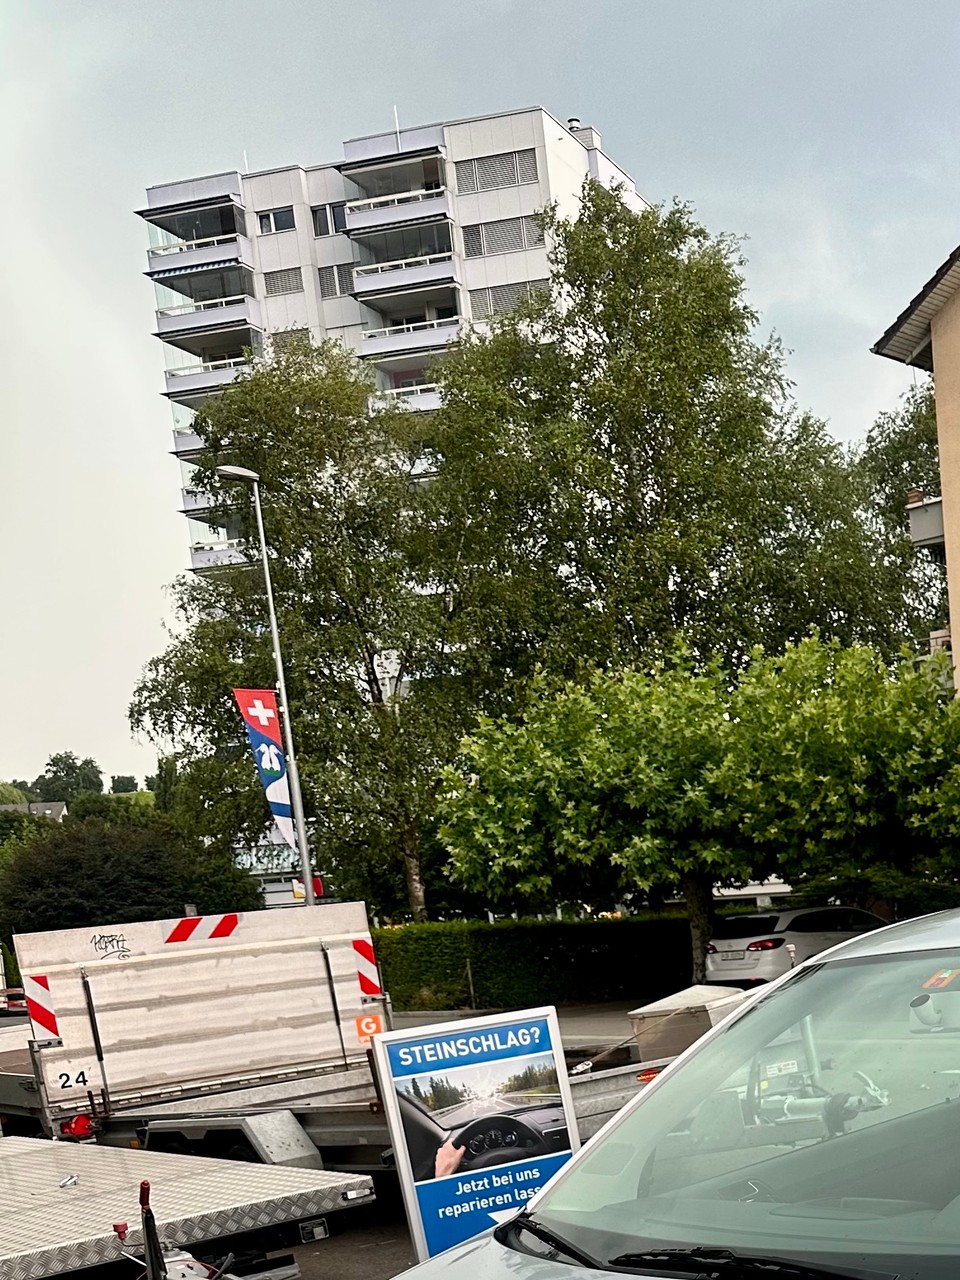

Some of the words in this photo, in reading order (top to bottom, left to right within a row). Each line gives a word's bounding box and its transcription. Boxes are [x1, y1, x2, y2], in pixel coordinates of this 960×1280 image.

[361, 1017, 377, 1034] G
[398, 1026, 541, 1066] STEINSCHLAG?
[58, 1070, 89, 1089] 24
[455, 1176, 490, 1195] Jetzt
[492, 1172, 513, 1187] bei
[515, 1167, 540, 1180] uns
[438, 1194, 513, 1218] reparieren
